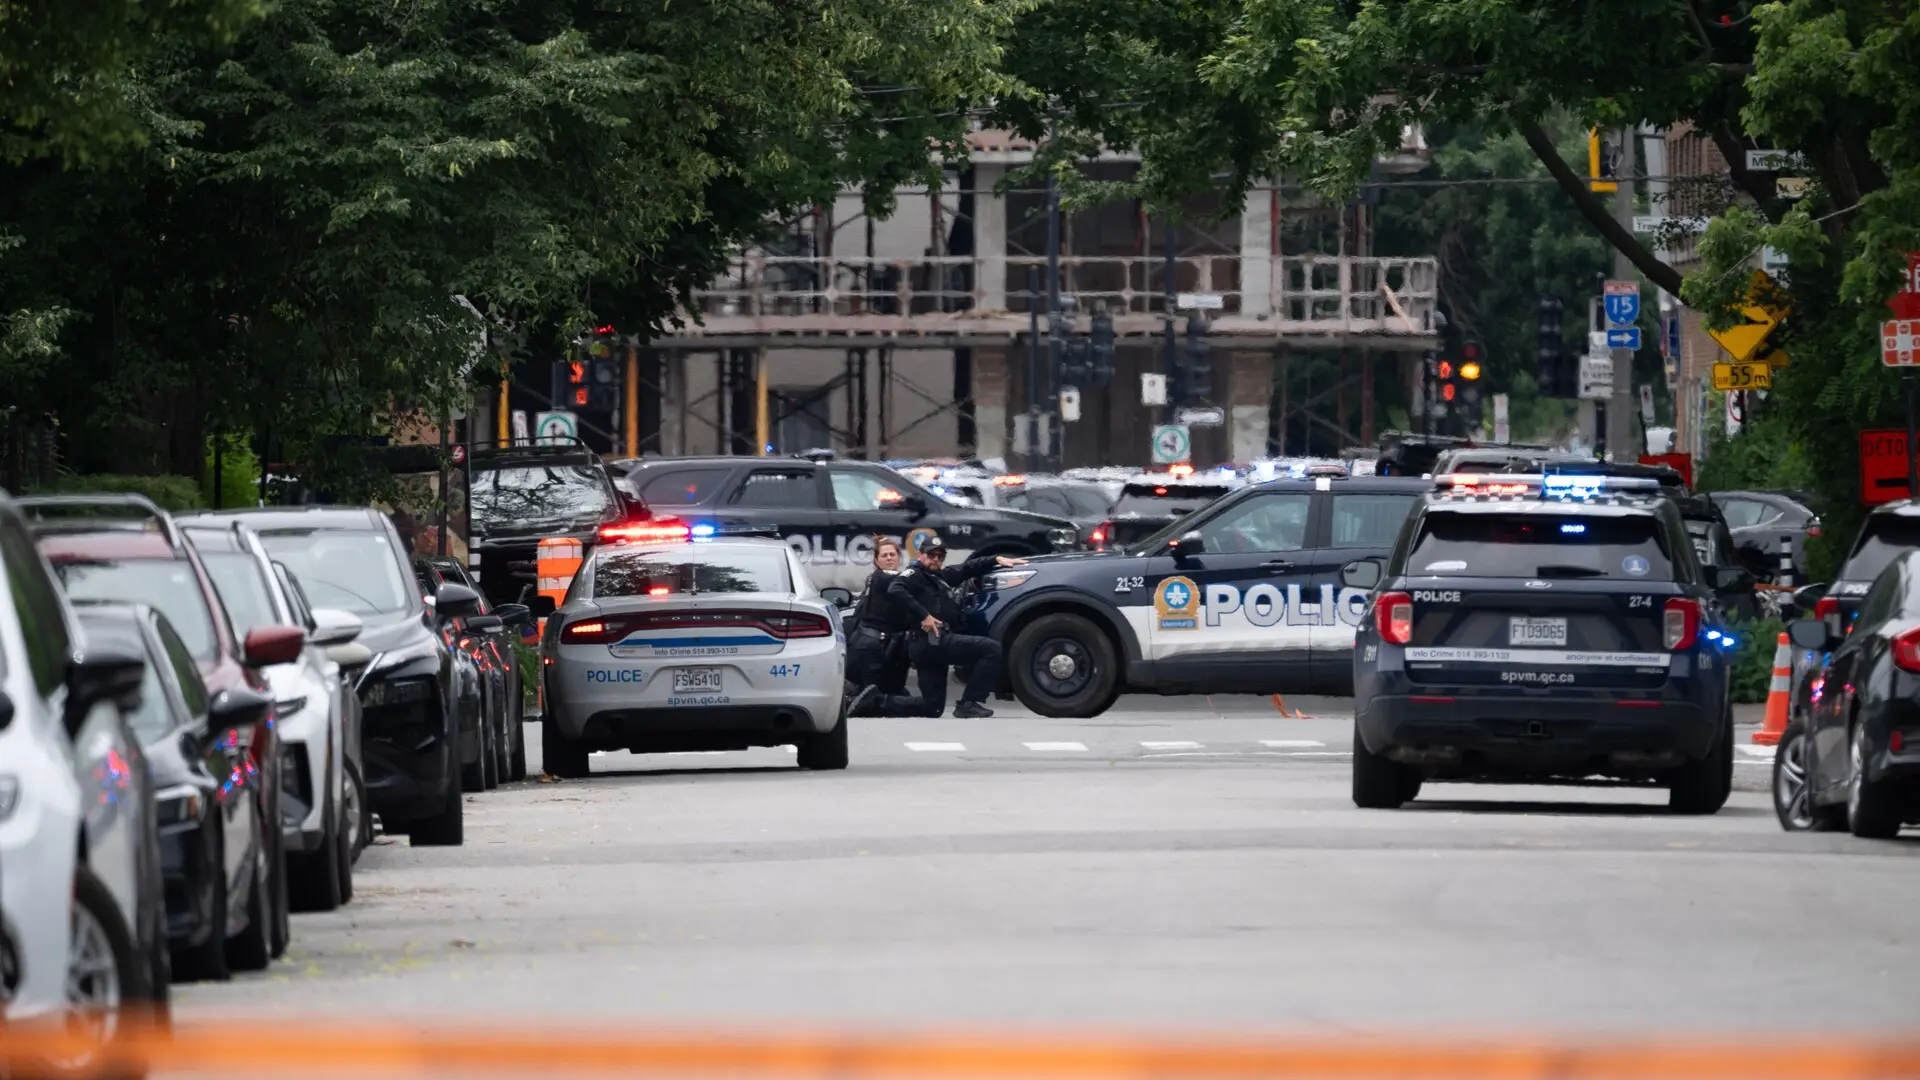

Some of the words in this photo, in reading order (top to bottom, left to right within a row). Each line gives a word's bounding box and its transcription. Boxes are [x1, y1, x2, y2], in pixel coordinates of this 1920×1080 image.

[1613, 296, 1633, 314] 15
[1731, 366, 1751, 386] 55
[1754, 375, 1768, 384] m
[1864, 436, 1904, 457] DÉTO
[785, 534, 902, 566] OLIC
[1116, 576, 1144, 588] 21-32
[1413, 590, 1461, 602] POLICE
[1843, 583, 1869, 596] POL
[1205, 583, 1369, 627] POLIC
[1629, 595, 1652, 608] 27-4
[654, 648, 668, 656] Info
[670, 647, 691, 656] Crime
[692, 647, 705, 655] 514
[706, 647, 738, 655] 393-1133
[1412, 650, 1428, 658] Info
[1430, 650, 1454, 658] Crime
[1456, 650, 1471, 658] 514
[587, 669, 642, 683] POLICE
[769, 664, 800, 677] 44-7
[675, 673, 720, 687] FSW5410
[1501, 672, 1575, 684] spvm.qc.ca
[667, 695, 730, 706] spvm.qc.ca
